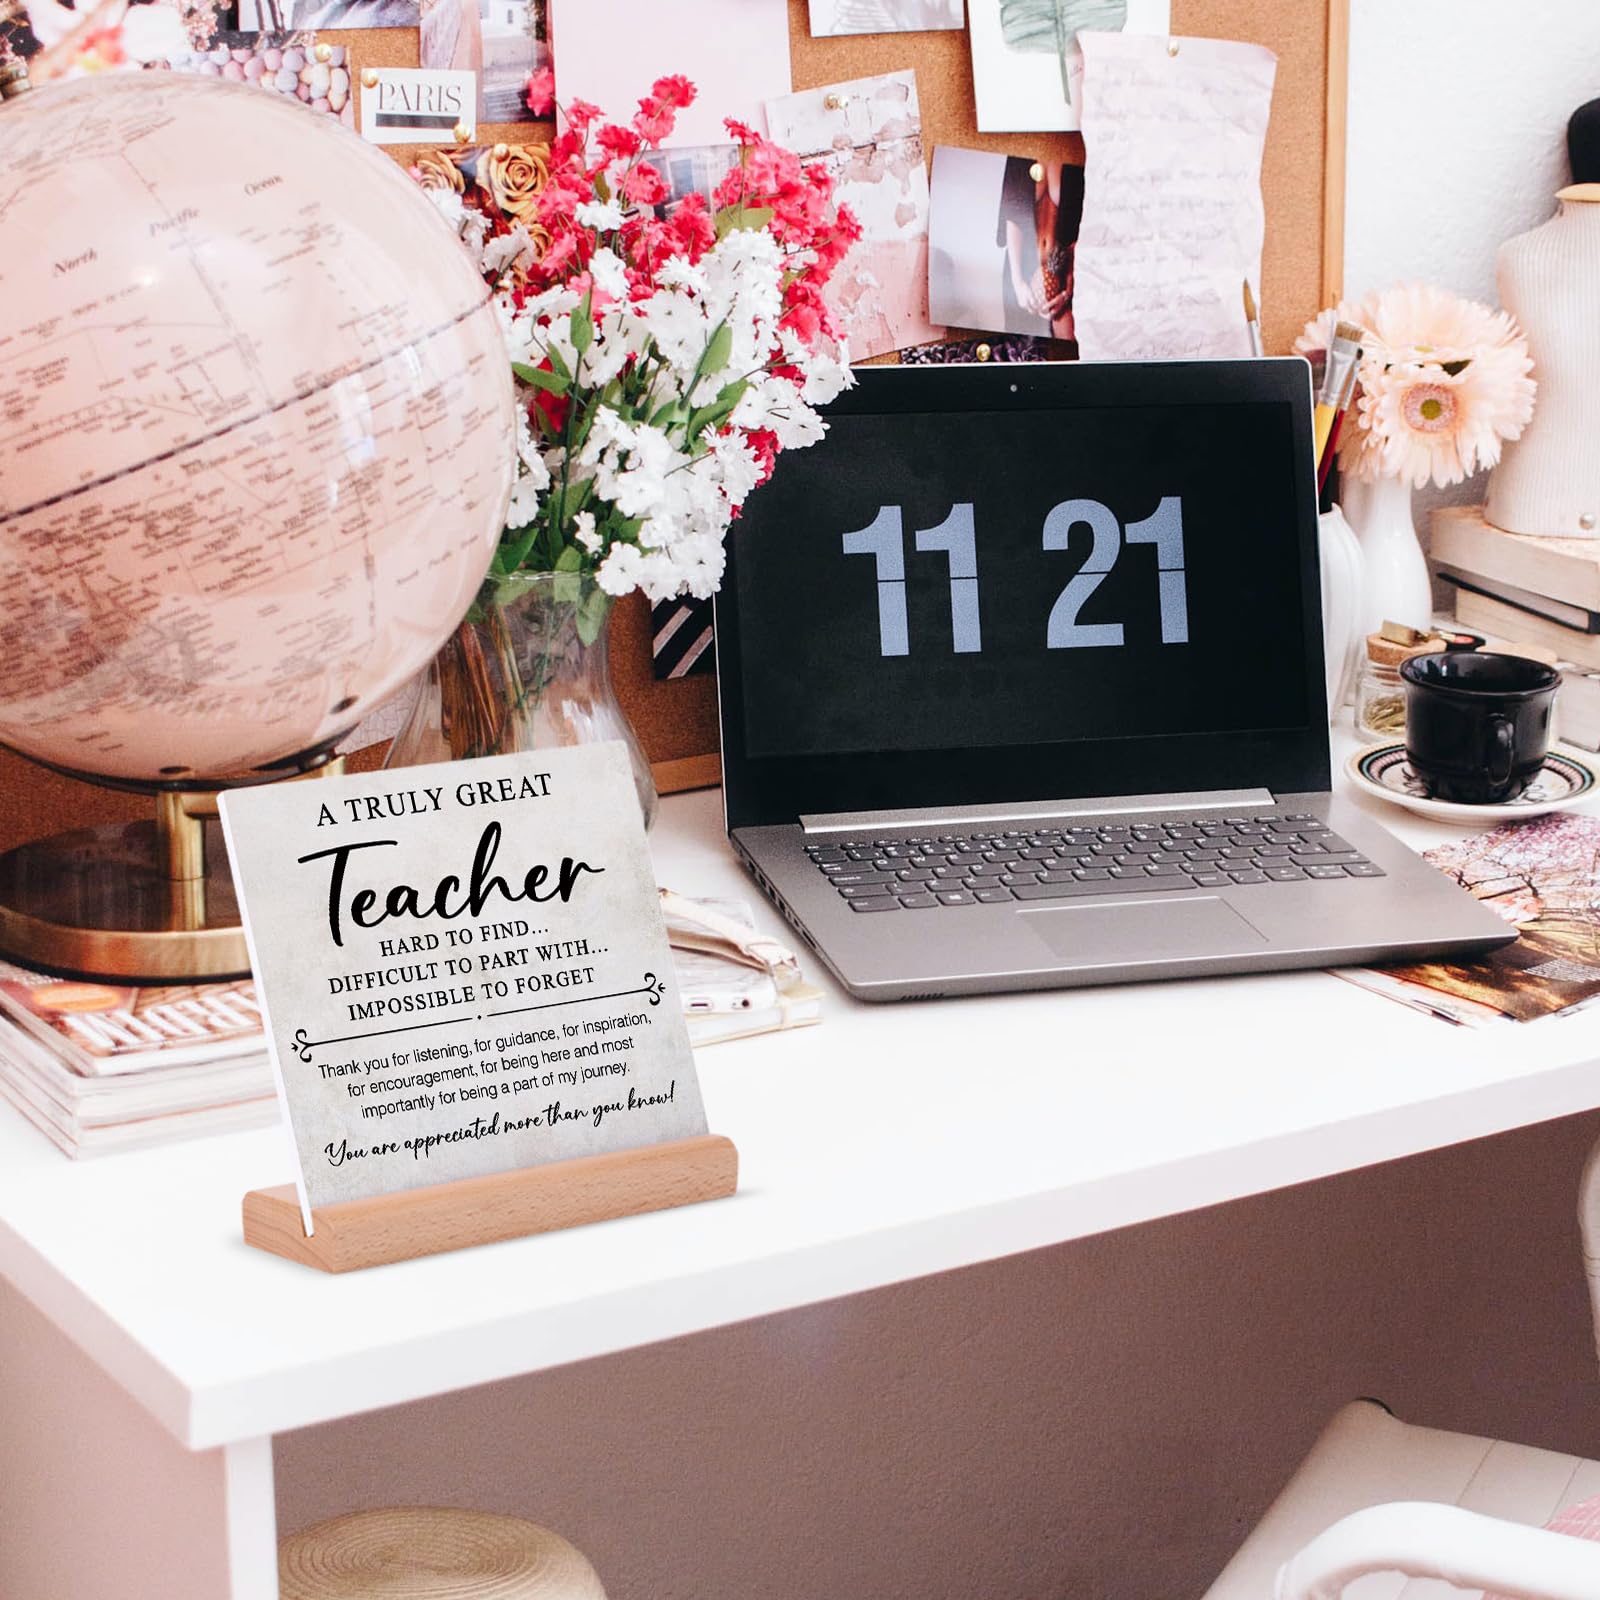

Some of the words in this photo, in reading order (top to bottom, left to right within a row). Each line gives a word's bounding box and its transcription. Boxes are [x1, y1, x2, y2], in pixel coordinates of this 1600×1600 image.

[377, 82, 463, 113] PARIS
[842, 502, 982, 657] 11
[1041, 495, 1190, 650] 21
[316, 802, 339, 828] A
[343, 786, 444, 823] TRULY
[455, 772, 552, 807] GREAT
[297, 820, 606, 948] Teacher
[327, 961, 439, 995] DIFFICULT
[443, 957, 473, 977] TO
[477, 947, 529, 972] PART
[534, 938, 609, 963] WITH...
[378, 933, 440, 958] HARD
[444, 927, 474, 947] TO
[478, 919, 549, 943] FIND...
[346, 985, 476, 1022] IMPOSSIBLE
[480, 980, 509, 1000] TO
[513, 966, 595, 995] FORGET
[317, 1059, 363, 1080] Thank
[363, 1057, 390, 1076] you
[391, 1052, 411, 1067] for
[412, 1043, 473, 1064] listening,
[473, 1038, 492, 1053] for
[495, 1028, 561, 1053] guidance,
[561, 1023, 580, 1038] for
[581, 1012, 652, 1035] inspiration,
[346, 1082, 366, 1098] for
[369, 1063, 479, 1094] encouragement,
[479, 1060, 498, 1075] for
[500, 1053, 540, 1072] being
[540, 1048, 571, 1065] here
[573, 1040, 600, 1059] and
[601, 1035, 635, 1054] most
[361, 1093, 436, 1120] importantly
[437, 1090, 457, 1105] for
[458, 1084, 499, 1102] being
[500, 1082, 511, 1095] a
[512, 1075, 540, 1096] part
[541, 1071, 555, 1087] of
[557, 1070, 578, 1086] my
[580, 1061, 631, 1084] journey.
[323, 1138, 369, 1167] You
[371, 1142, 401, 1156] are
[403, 1111, 501, 1161] appreciated
[503, 1116, 544, 1134] more
[541, 1100, 589, 1127] than
[591, 1101, 625, 1128] you
[627, 1079, 676, 1112] know!
